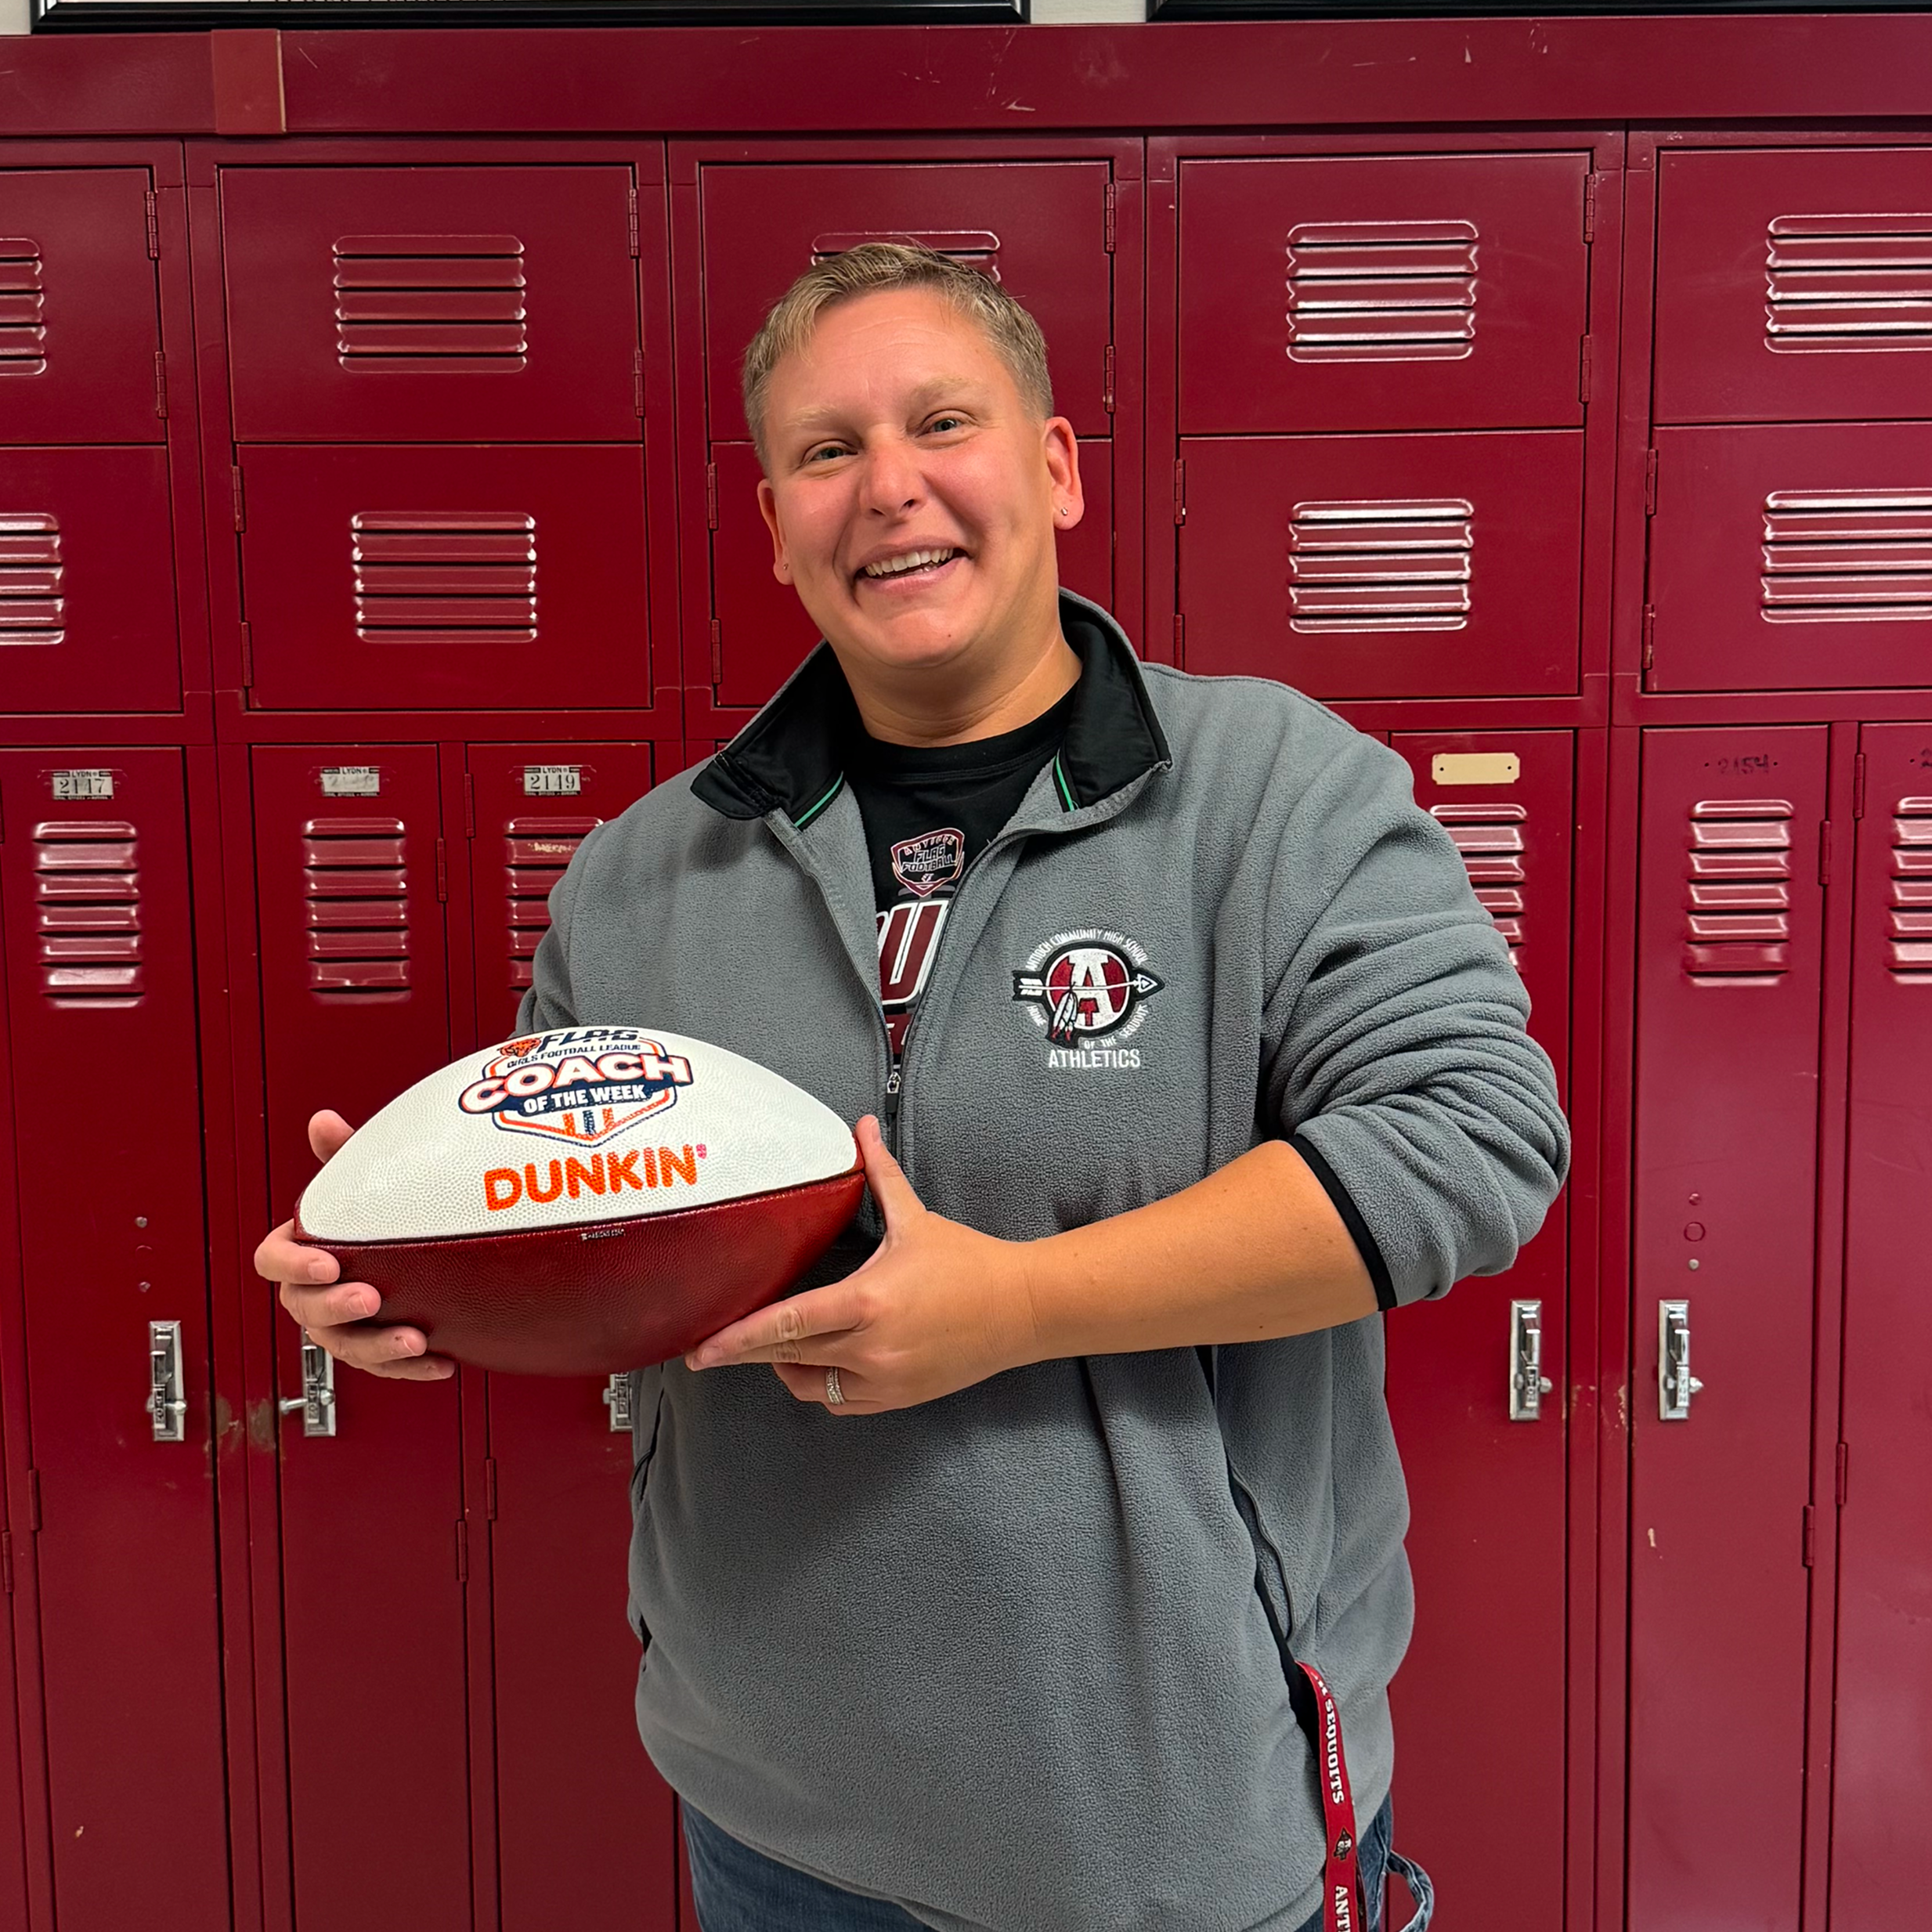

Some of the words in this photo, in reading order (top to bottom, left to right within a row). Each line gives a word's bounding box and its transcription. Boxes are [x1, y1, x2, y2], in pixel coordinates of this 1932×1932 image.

[901, 854, 957, 874] FOOTBALL
[914, 843, 946, 863] FLAG
[1049, 927, 1103, 946] COMMUNITY
[1102, 930, 1126, 945] HIGH
[1122, 937, 1150, 967] SCHOOL
[536, 1029, 639, 1053] FLAG
[1026, 1004, 1048, 1027] HOME
[1083, 1040, 1096, 1050] OF
[1100, 1035, 1118, 1048] THE
[507, 1053, 539, 1069] GIRLS
[540, 1045, 597, 1060] FOOTBALL
[599, 1043, 641, 1052] LEAGUE
[1048, 1048, 1141, 1069] ATHLETICS
[459, 1052, 695, 1114] COACH
[523, 1096, 548, 1114] OF
[551, 1089, 589, 1107] THE
[589, 1084, 647, 1103] WEEK
[1324, 1698, 1345, 1805] SEQUOITS
